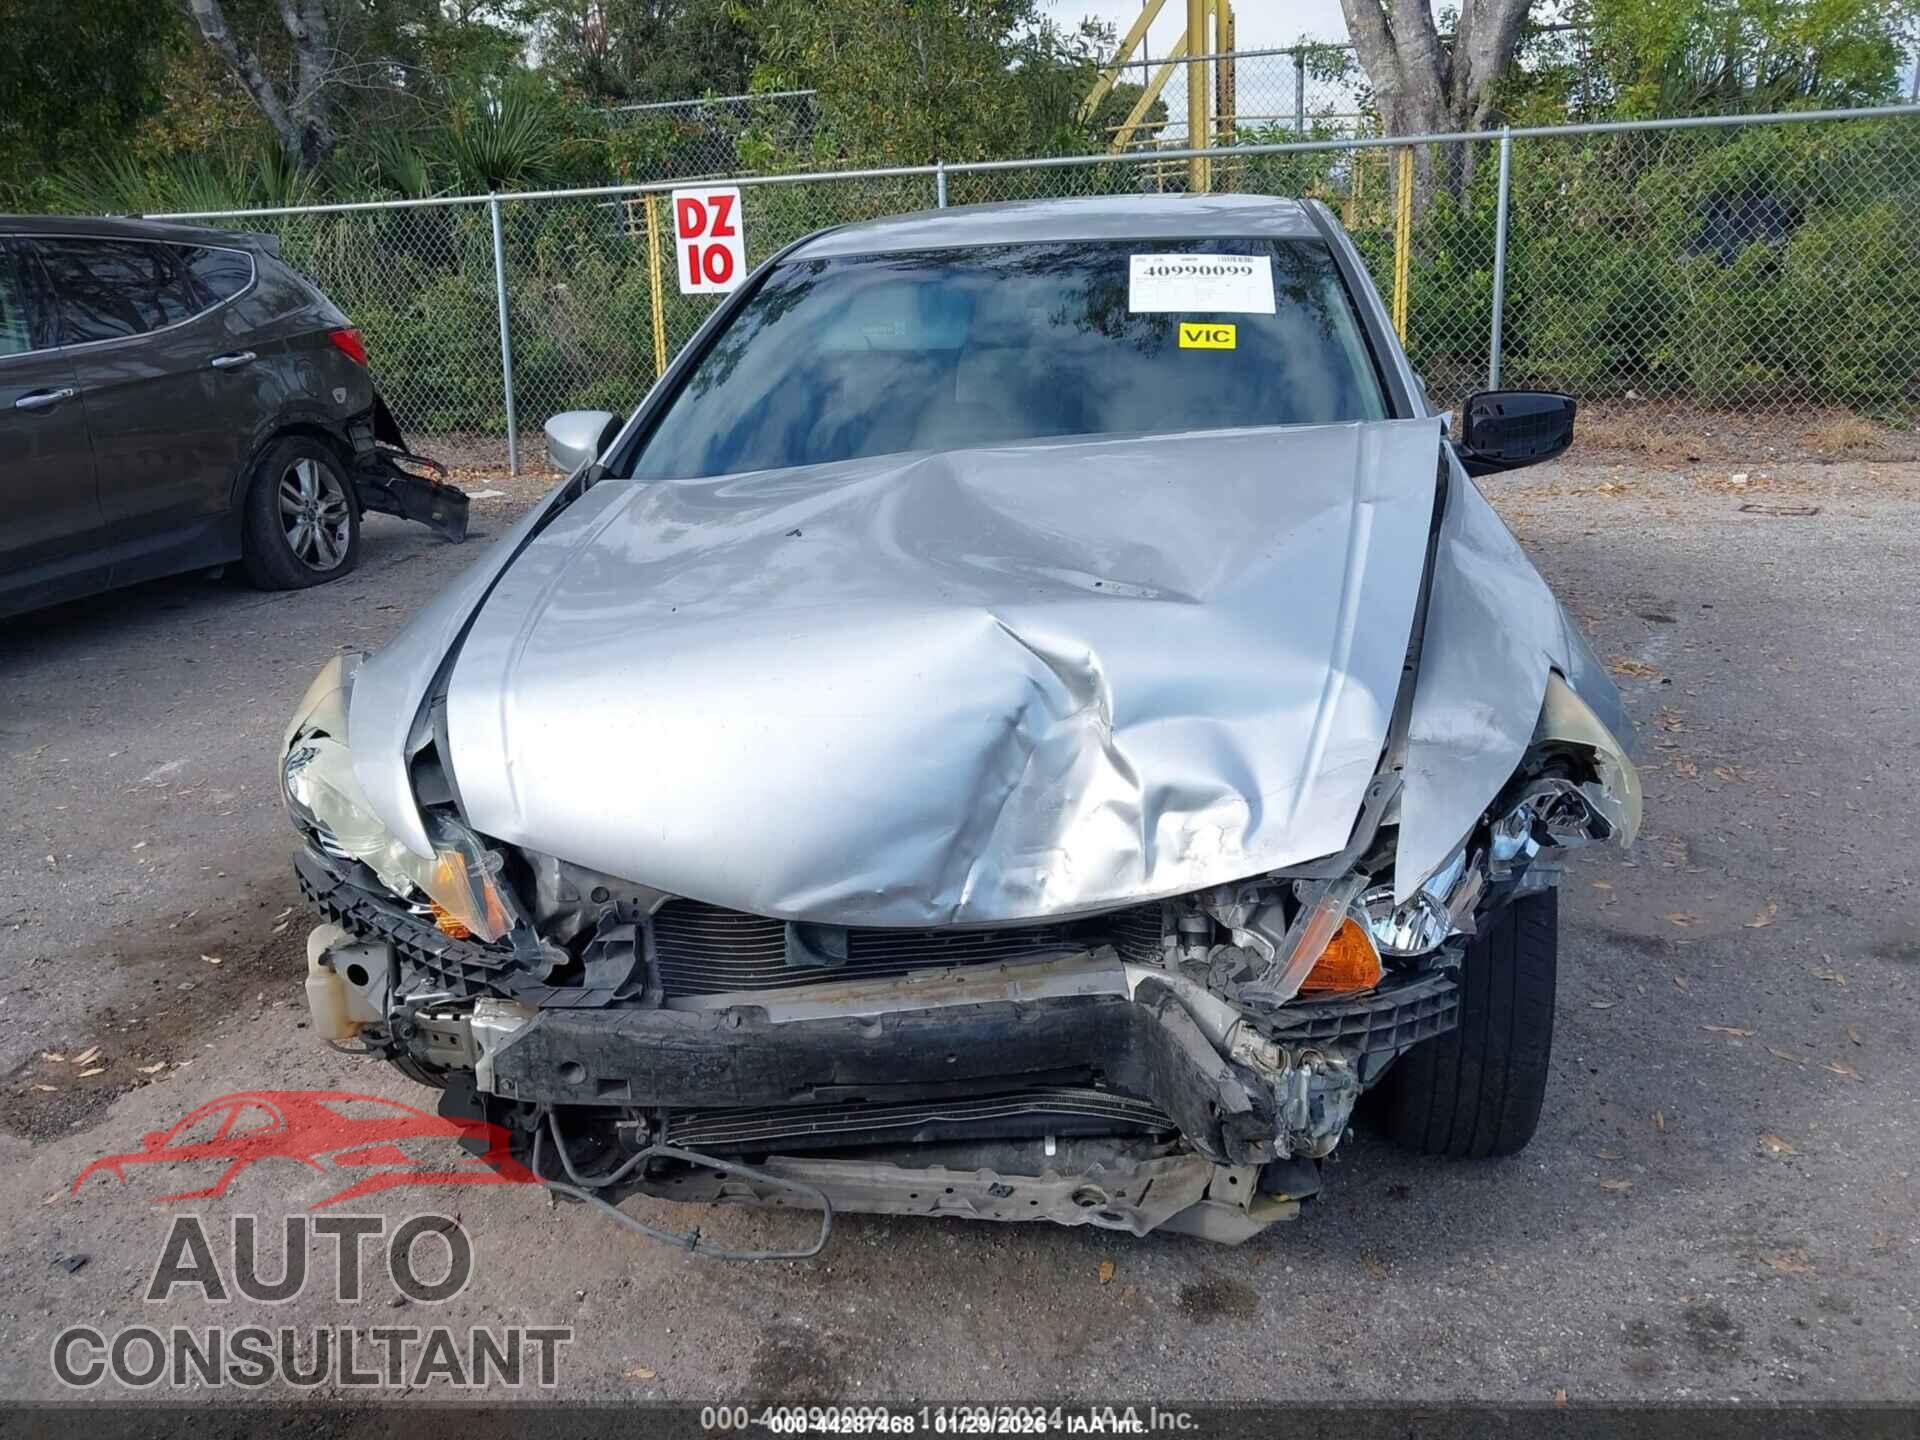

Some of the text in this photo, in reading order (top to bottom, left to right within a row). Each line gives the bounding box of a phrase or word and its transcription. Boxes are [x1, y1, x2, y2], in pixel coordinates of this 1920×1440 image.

[677, 195, 735, 239] DZ
[1143, 265, 1253, 277] 40990099
[1185, 329, 1230, 343] VIC
